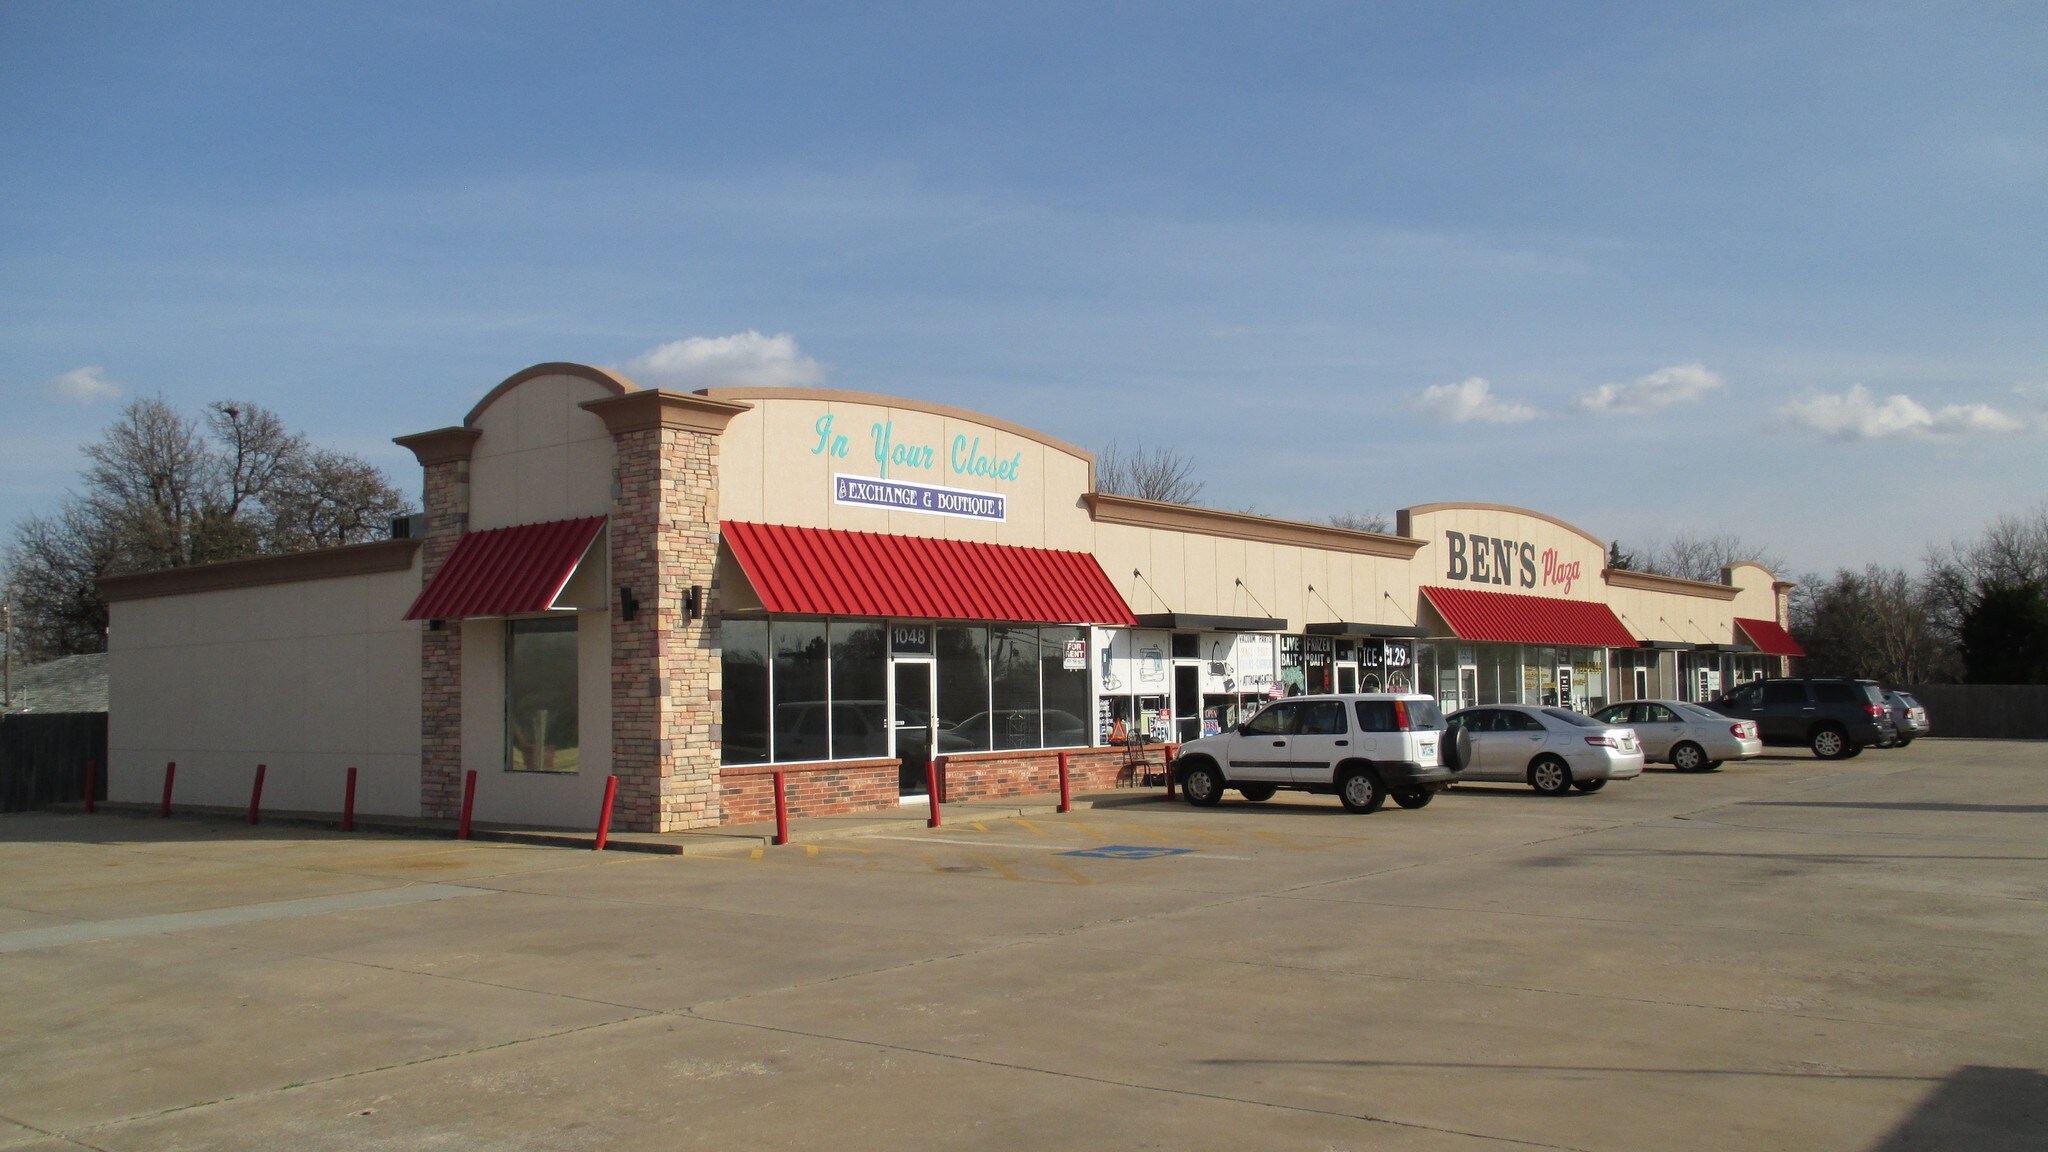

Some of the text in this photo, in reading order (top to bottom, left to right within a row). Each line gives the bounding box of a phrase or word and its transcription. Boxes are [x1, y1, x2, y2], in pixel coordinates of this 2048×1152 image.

[811, 414, 1021, 481] In Your Closet
[848, 482, 918, 505] EXCHANGE
[938, 493, 995, 515] BOUTIQUE
[1445, 530, 1581, 595] BEN'S Plaza
[894, 629, 925, 644] 1048
[1281, 637, 1300, 651] LIVE
[1306, 638, 1331, 651] FROZEN
[1065, 650, 1084, 658] RENT
[1281, 653, 1298, 666] BAIT
[1310, 653, 1325, 667] BAIT
[1362, 647, 1378, 667] ICE
[1204, 710, 1218, 718] OPEN
